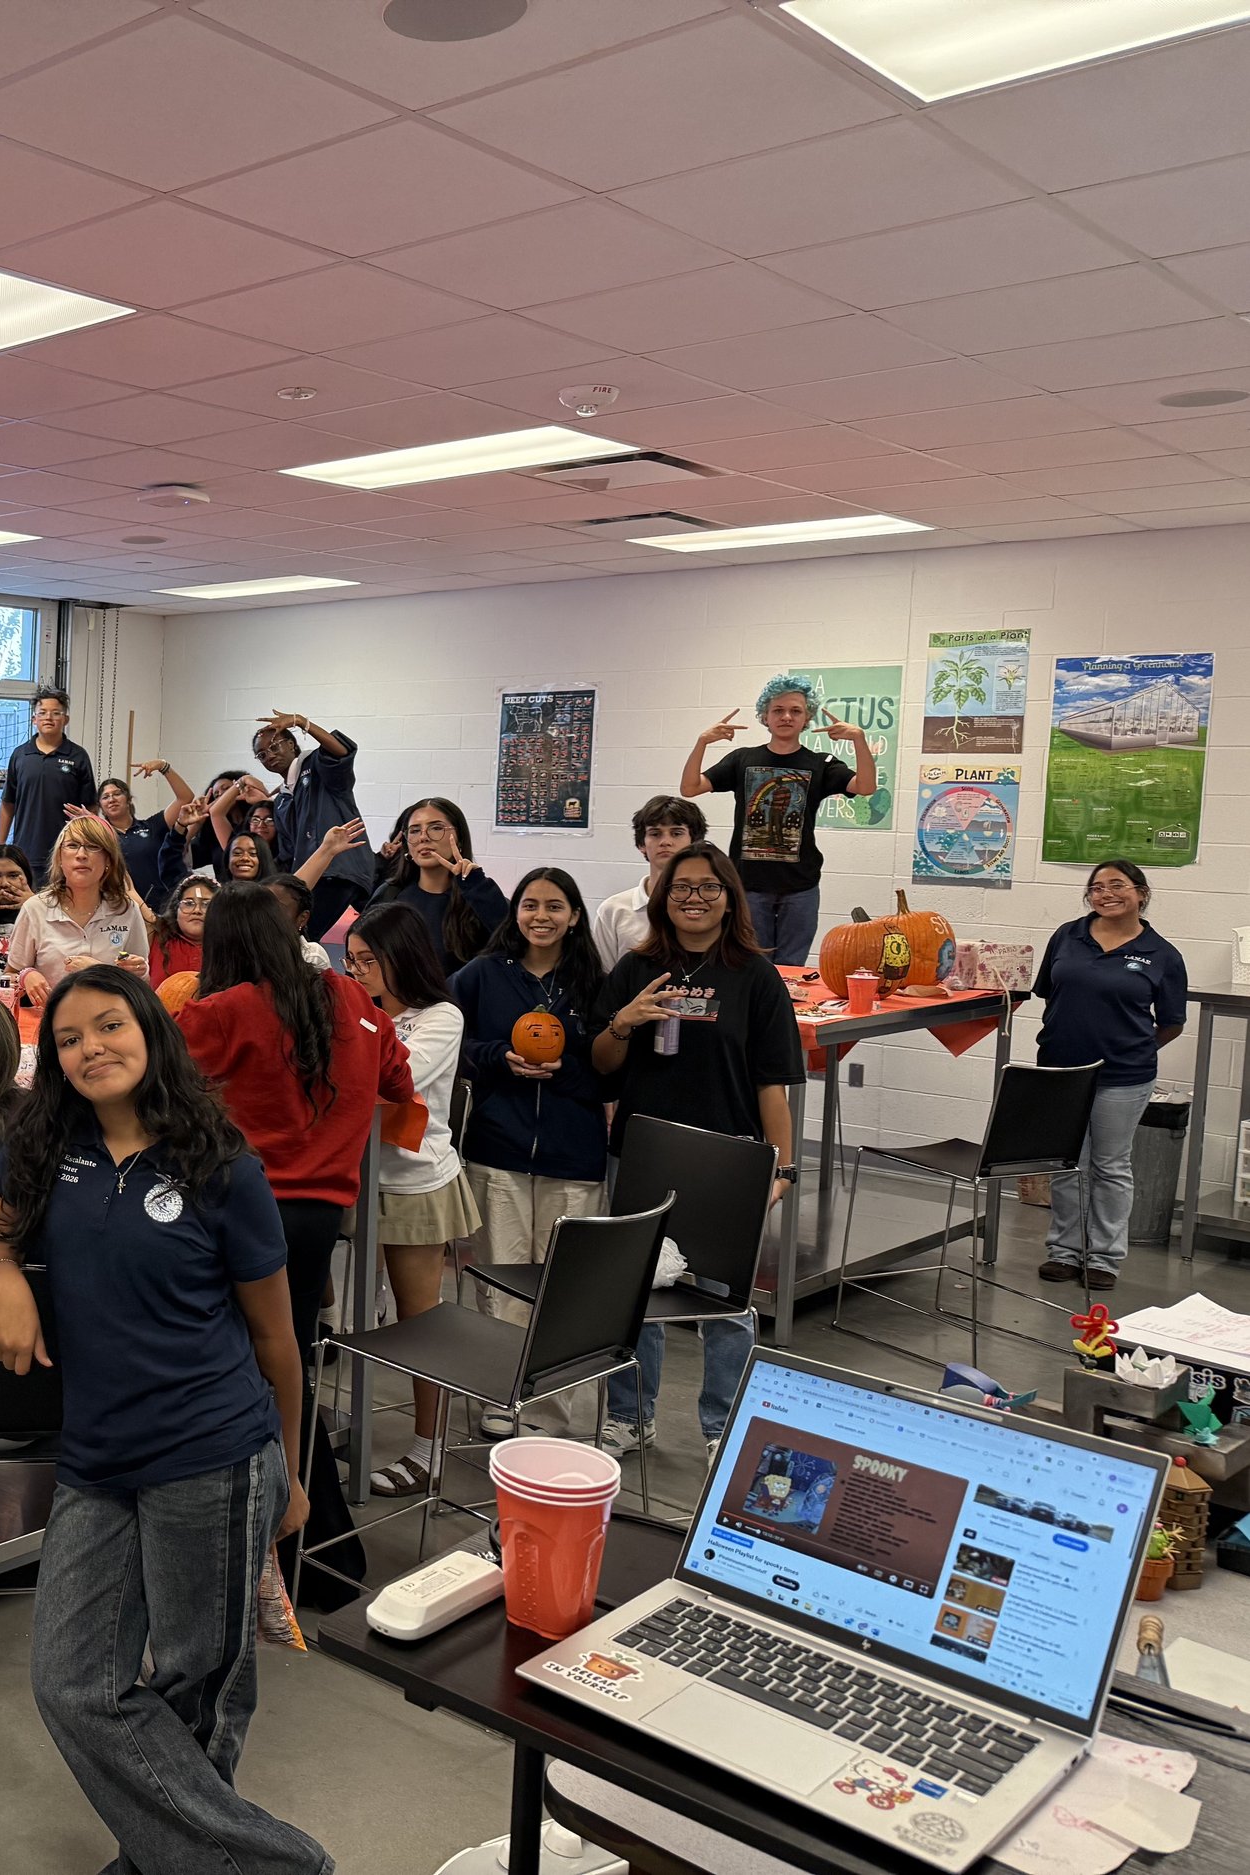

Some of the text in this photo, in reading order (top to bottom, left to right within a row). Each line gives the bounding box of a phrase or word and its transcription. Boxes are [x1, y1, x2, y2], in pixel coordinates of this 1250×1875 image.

[592, 386, 612, 394] FIRE
[948, 633, 974, 642] Parts
[977, 633, 986, 641] of
[1000, 631, 1028, 640] Plant
[1082, 661, 1123, 672] Planning
[504, 695, 554, 704] BEEF CUTS
[812, 696, 894, 730] CTUS
[955, 768, 993, 780] PLANT
[100, 924, 128, 933] LAMAR
[64, 1154, 97, 1168] Escalante
[60, 1173, 79, 1184] 2026
[852, 1454, 909, 1482] SPOOKY
[708, 1538, 734, 1553] Halloween
[734, 1548, 754, 1560] Playlist
[764, 1559, 783, 1571] spooky
[783, 1566, 799, 1576] times
[546, 1662, 629, 1700] IN YOURSELF
[572, 1666, 617, 1688] BELEAF
